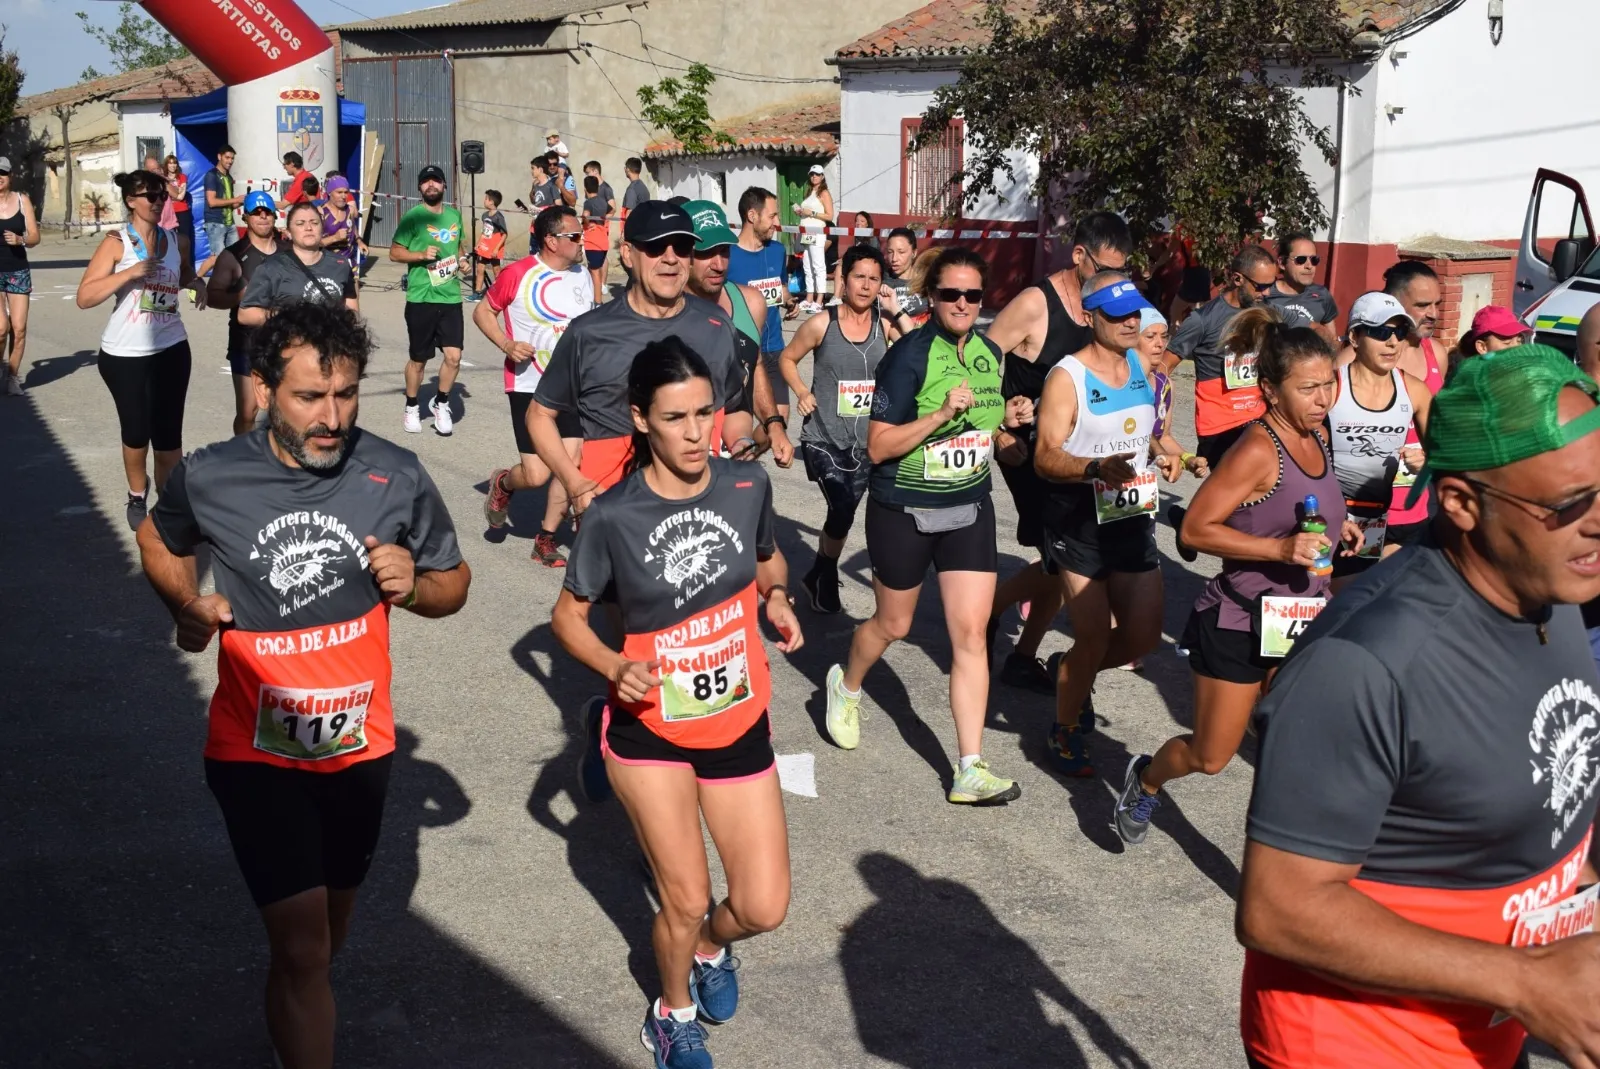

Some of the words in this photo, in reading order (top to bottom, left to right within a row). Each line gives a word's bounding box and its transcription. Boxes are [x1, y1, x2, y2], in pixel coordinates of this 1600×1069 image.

[438, 266, 451, 278] 84
[151, 291, 166, 306] 14
[853, 394, 870, 408] 24
[1336, 425, 1405, 434] 37300
[941, 449, 976, 468] 101
[1093, 444, 1105, 453] EL
[1115, 488, 1139, 508] 60
[258, 511, 310, 545] Carrera
[648, 510, 692, 546] Carrera
[693, 507, 744, 554] Solidaria
[279, 603, 291, 617] Un
[293, 593, 316, 611] Nuevo
[674, 596, 685, 609] Un
[255, 636, 298, 655] COCA
[300, 630, 323, 653] DE
[326, 618, 368, 647] ALBA
[654, 626, 689, 649] COCA
[688, 616, 710, 640] DE
[660, 639, 745, 675] bedunia
[693, 666, 728, 701] 85
[261, 690, 369, 716] bedunia
[1528, 684, 1564, 754] Carrera
[1562, 677, 1600, 713] Solida
[283, 712, 348, 744] 119
[1502, 874, 1559, 922] COCA
